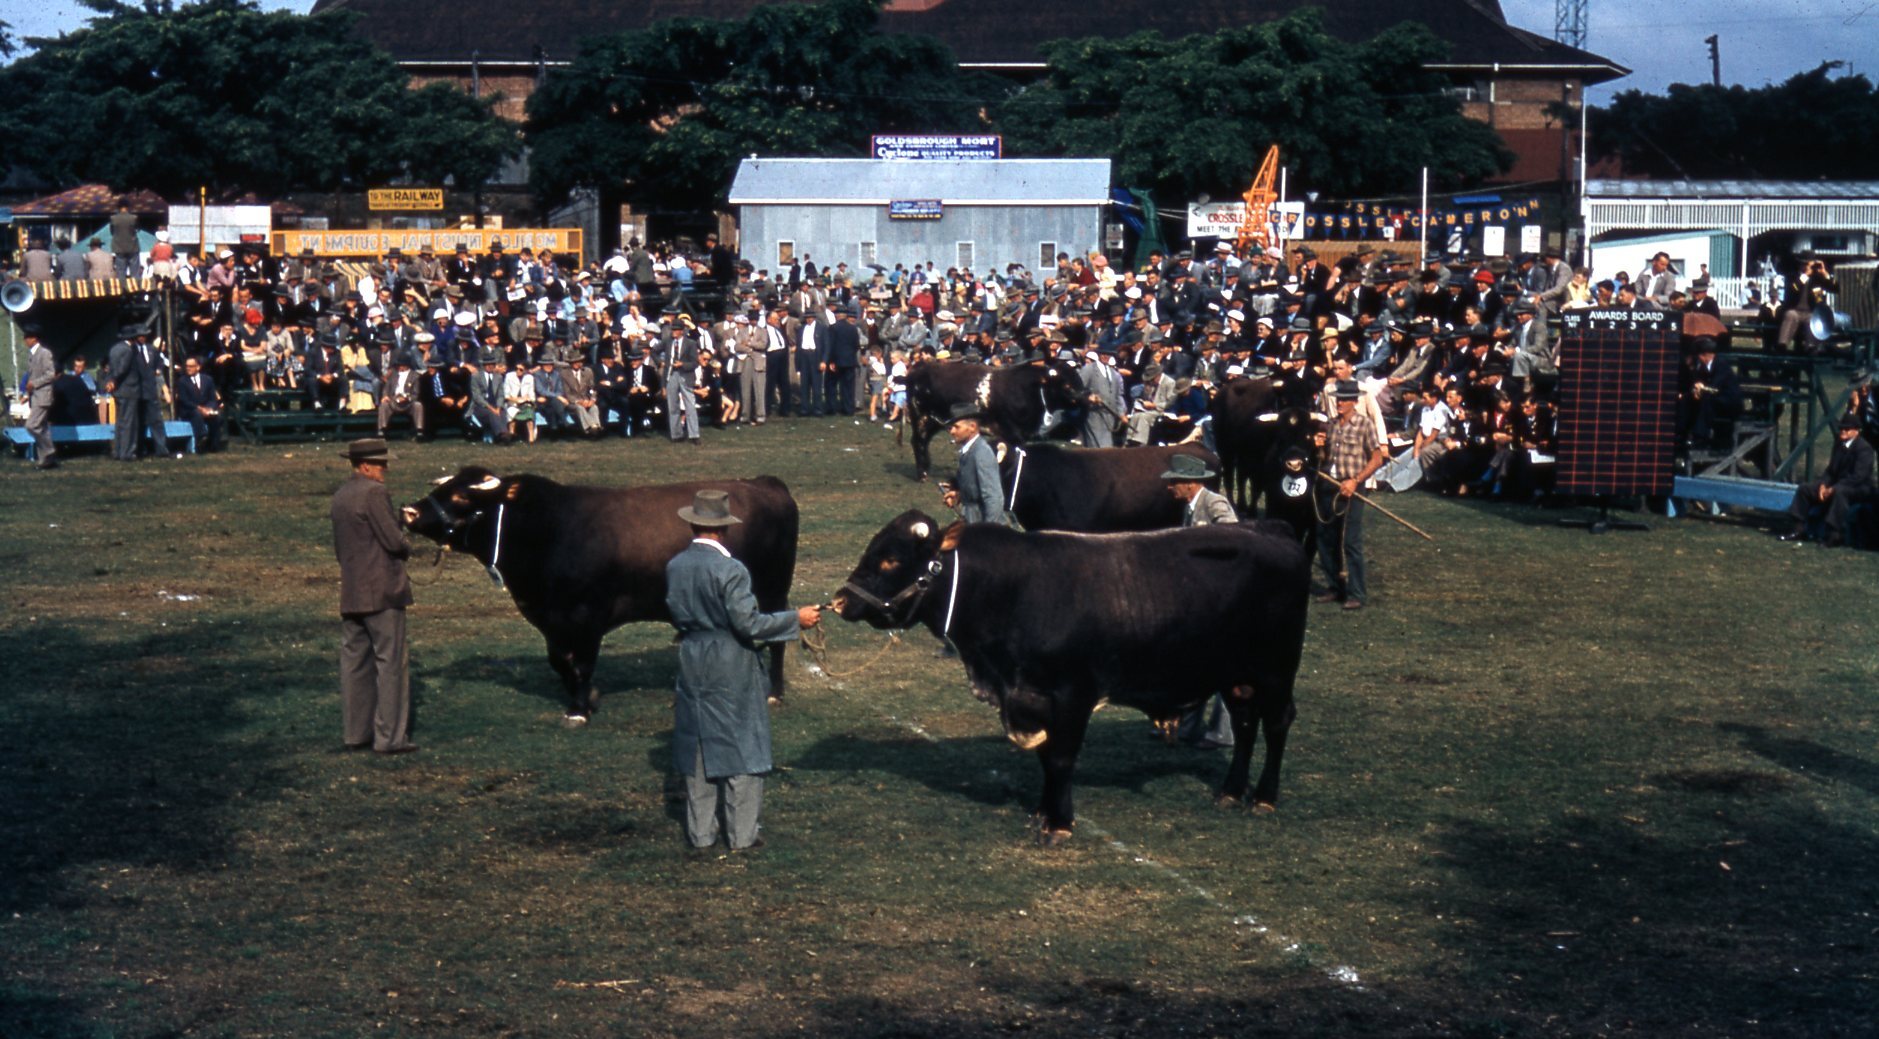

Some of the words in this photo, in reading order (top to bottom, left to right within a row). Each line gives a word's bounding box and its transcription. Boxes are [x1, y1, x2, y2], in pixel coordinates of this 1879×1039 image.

[876, 137, 957, 145] GOLDSBROUGH
[961, 137, 995, 145] MORT
[877, 147, 919, 158] Cyclone
[394, 191, 440, 200] RAILWAY
[1207, 212, 1243, 223] CROSSLE
[1197, 225, 1214, 233] MEET
[1218, 225, 1231, 233] THE
[1589, 311, 1628, 320] AWARDS
[1632, 312, 1664, 321] BOARD
[1590, 320, 1595, 329] 1
[1609, 321, 1616, 329] 2
[1630, 321, 1637, 330] 3
[1650, 322, 1658, 330] 4
[1671, 322, 1677, 331] 5
